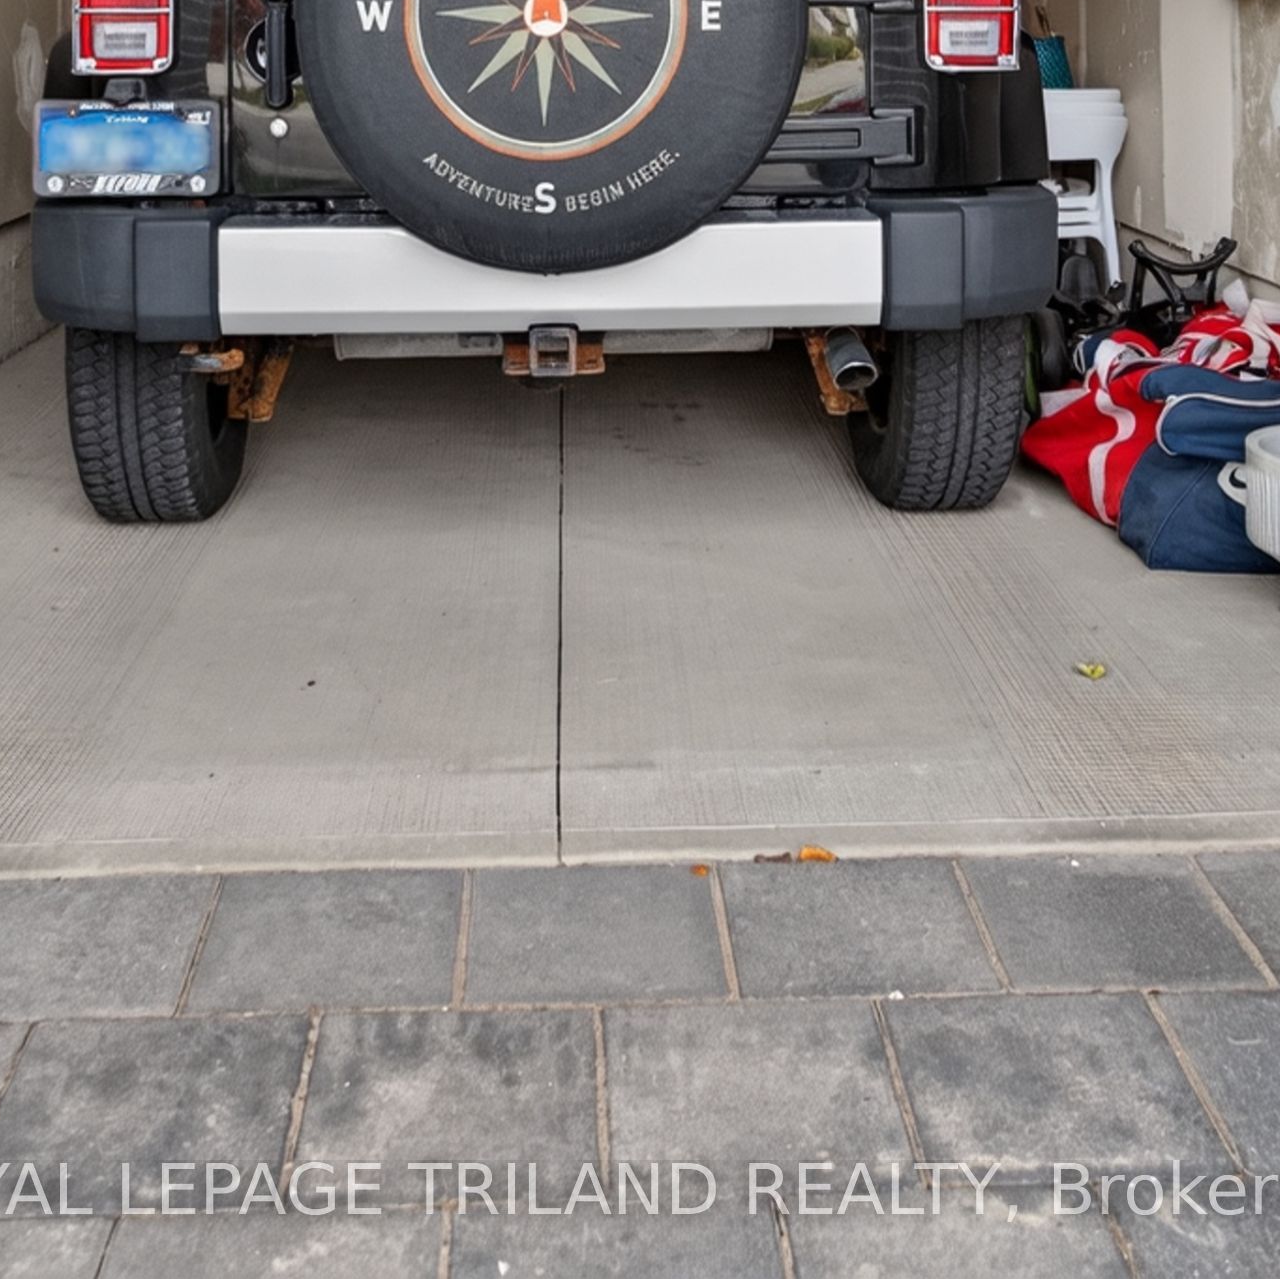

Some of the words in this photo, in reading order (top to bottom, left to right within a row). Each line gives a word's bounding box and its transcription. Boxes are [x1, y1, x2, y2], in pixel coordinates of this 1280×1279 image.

[355, 0, 394, 33] W
[701, 0, 723, 32] E
[565, 180, 625, 213] BEGIN
